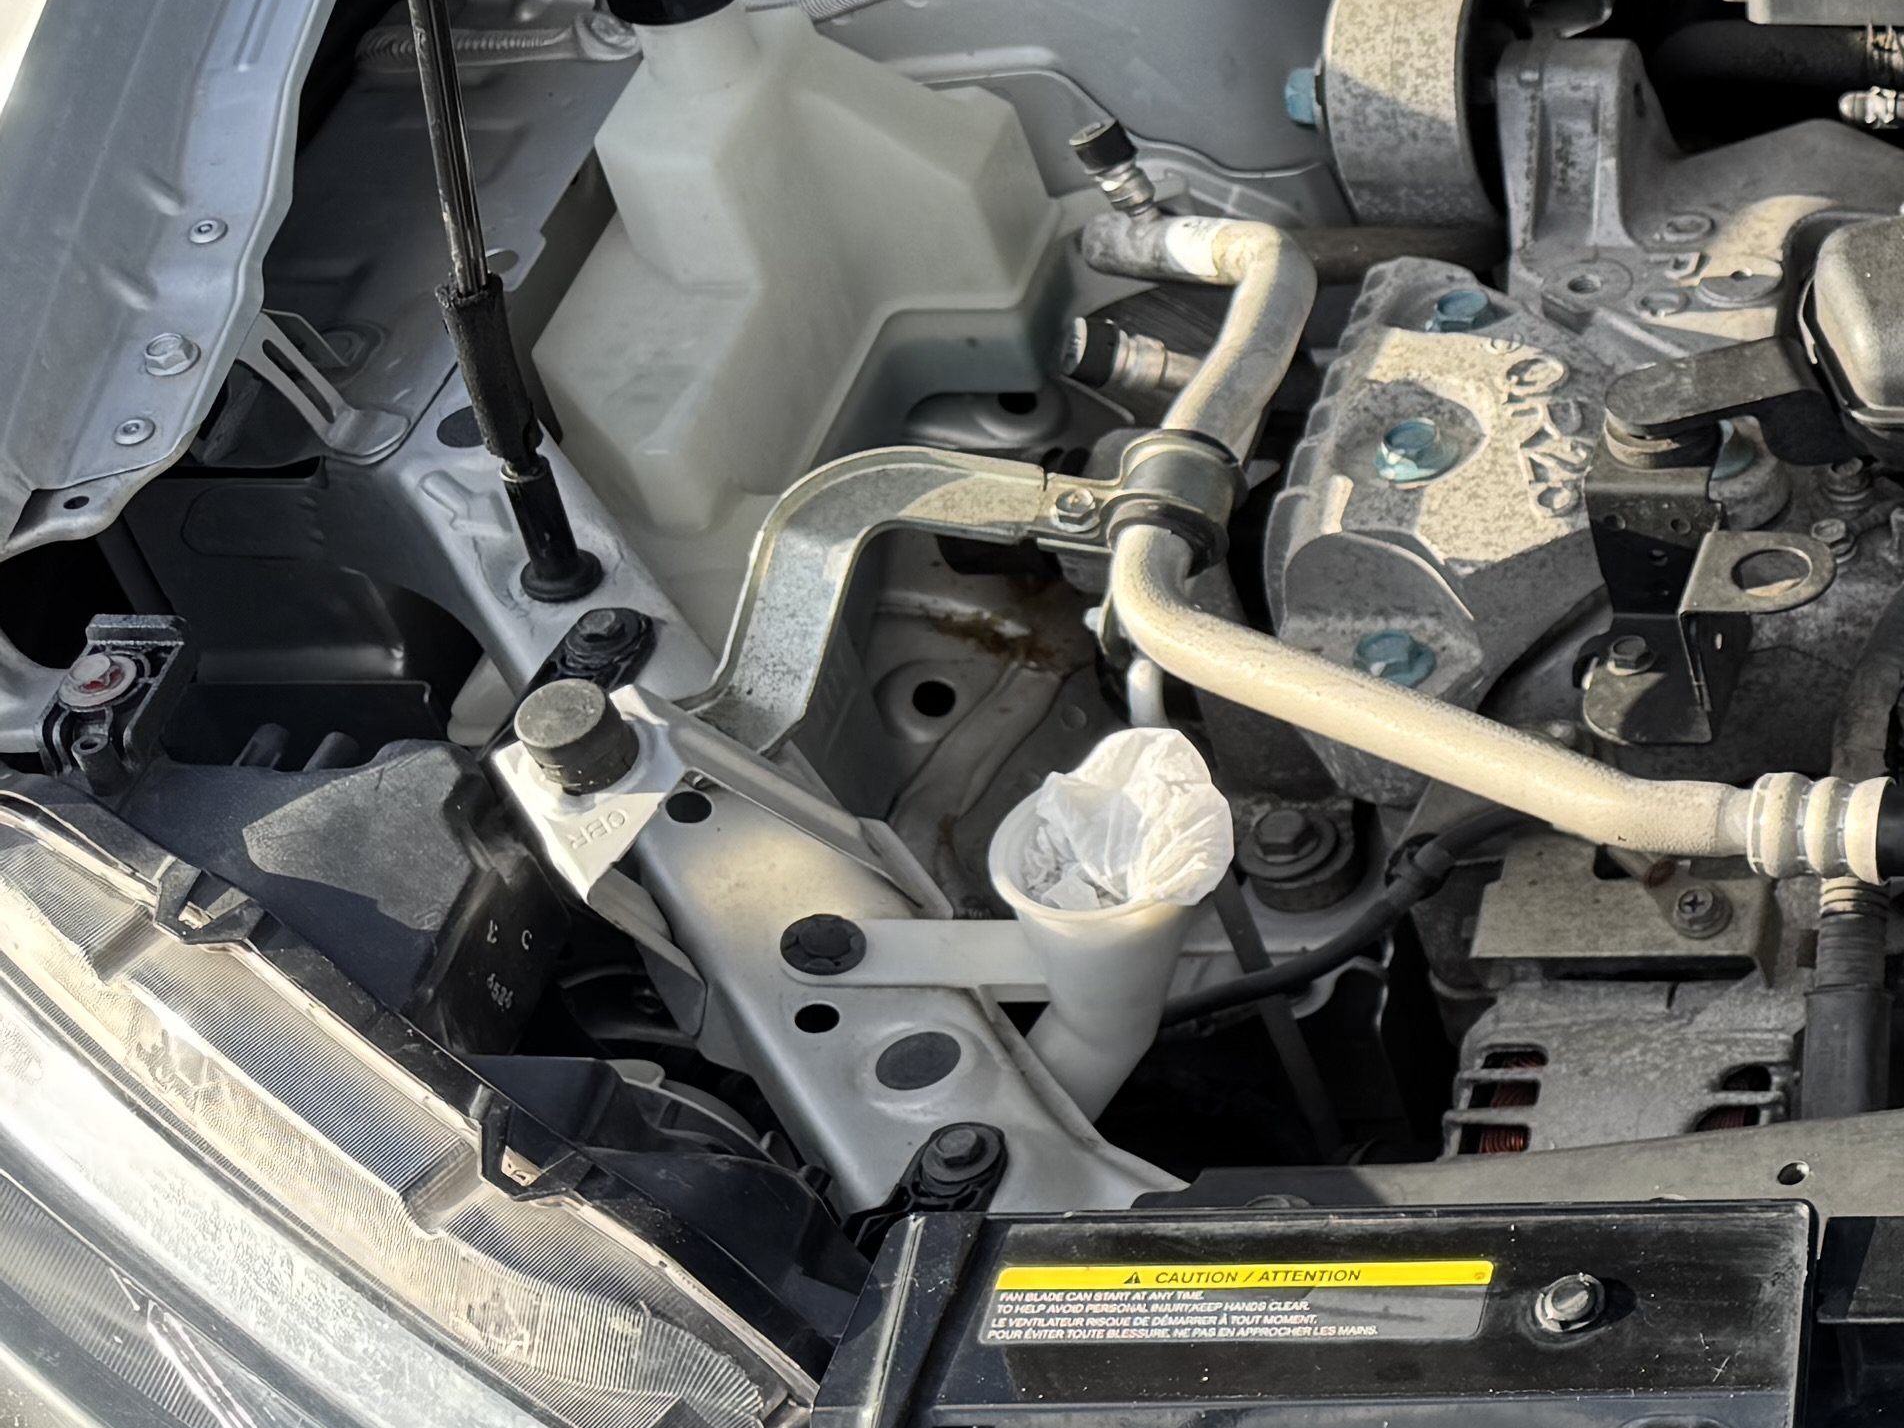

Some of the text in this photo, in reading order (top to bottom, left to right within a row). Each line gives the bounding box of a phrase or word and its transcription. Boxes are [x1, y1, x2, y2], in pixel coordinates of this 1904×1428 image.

[1155, 1271, 1238, 1284] CAUTION
[1258, 1269, 1361, 1282] ATTENTION
[1000, 1292, 1023, 1301] FAN
[1025, 1292, 1064, 1301] BLADE
[1066, 1292, 1091, 1301] CAN
[1093, 1292, 1130, 1301] START
[1131, 1292, 1148, 1301] AT
[1149, 1291, 1174, 1301] ANY
[997, 1304, 1013, 1314] TO
[1014, 1304, 1046, 1314] HELP
[1047, 1304, 1084, 1313] AVOID
[1085, 1303, 1148, 1313] PERSONAL
[1224, 1302, 1266, 1311] HANDS
[1268, 1301, 1310, 1311] CLEAR.
[992, 1318, 1006, 1328] LE
[1008, 1317, 1084, 1327] VENTILATEUR
[1085, 1317, 1132, 1327] RISQUE
[1133, 1316, 1150, 1326] DE
[1151, 1314, 1217, 1326] DÉMARRER
[1231, 1315, 1262, 1325] TOUT
[1263, 1314, 1318, 1324] MOMENT.
[988, 1330, 1023, 1340] POUR
[1024, 1327, 1064, 1339] ÉVITER
[1066, 1329, 1106, 1339] TOUTE
[1172, 1328, 1193, 1338] NE
[1195, 1327, 1216, 1337] PAS
[1217, 1327, 1236, 1337] EN
[1236, 1326, 1311, 1337] APPROCHER
[1312, 1326, 1336, 1336] LES
